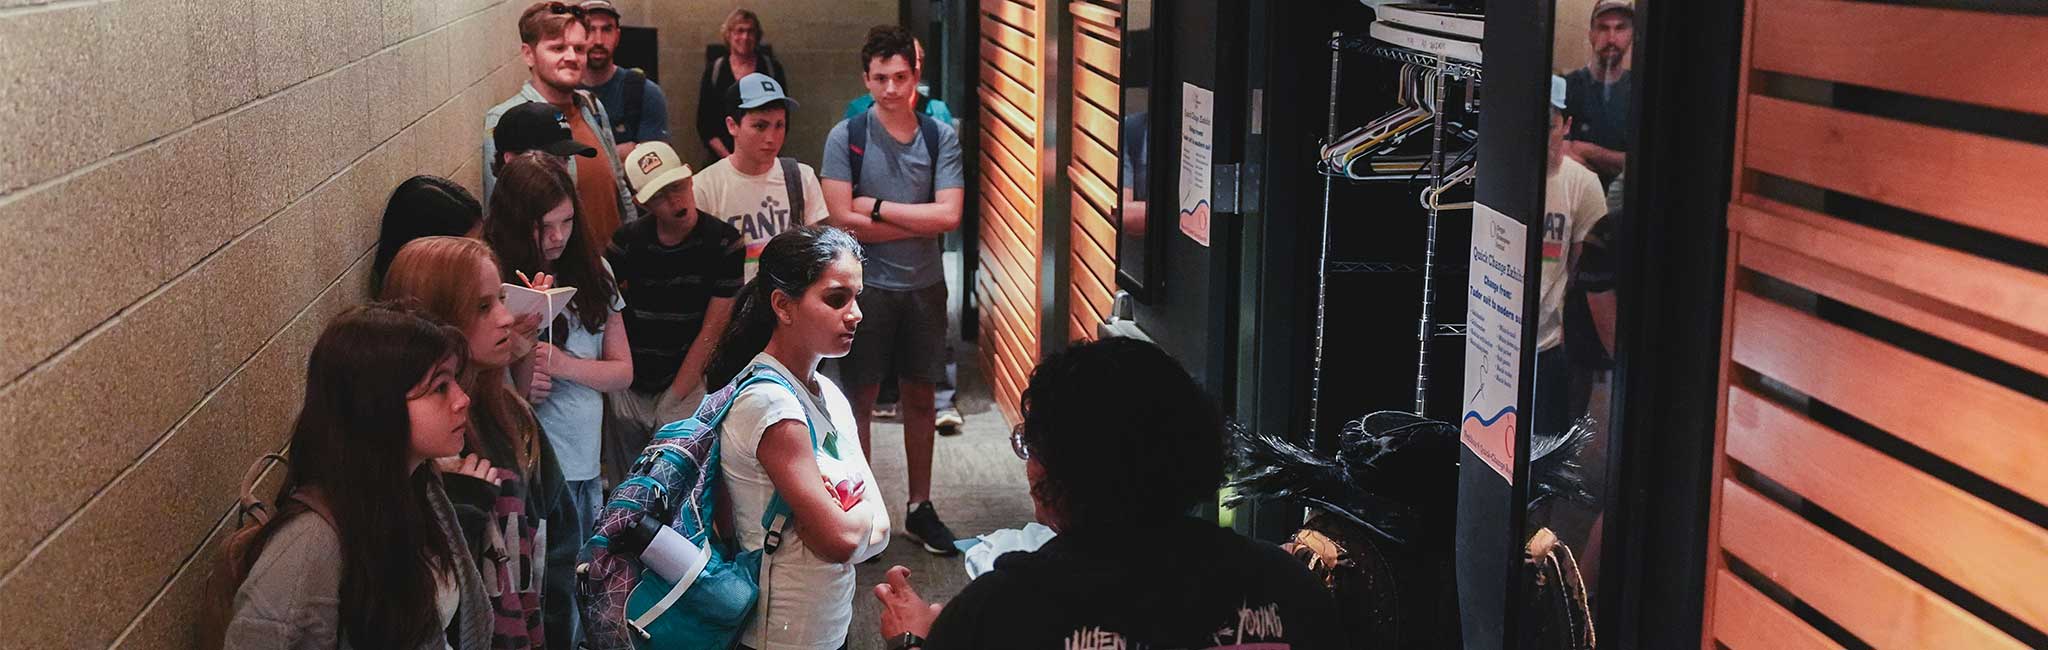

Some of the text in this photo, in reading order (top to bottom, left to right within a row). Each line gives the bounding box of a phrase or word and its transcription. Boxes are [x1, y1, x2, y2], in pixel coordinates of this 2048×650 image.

[727, 205, 790, 240] FANT
[1473, 246, 1523, 282] Quick Change Exhibi
[1484, 274, 1499, 293] Change
[1470, 285, 1482, 301] Tudor
[1483, 295, 1491, 306] suit
[1491, 299, 1497, 309] to
[1496, 304, 1514, 321] modern
[1064, 625, 1127, 650] WHEN
[1237, 597, 1283, 645] YOUNG
